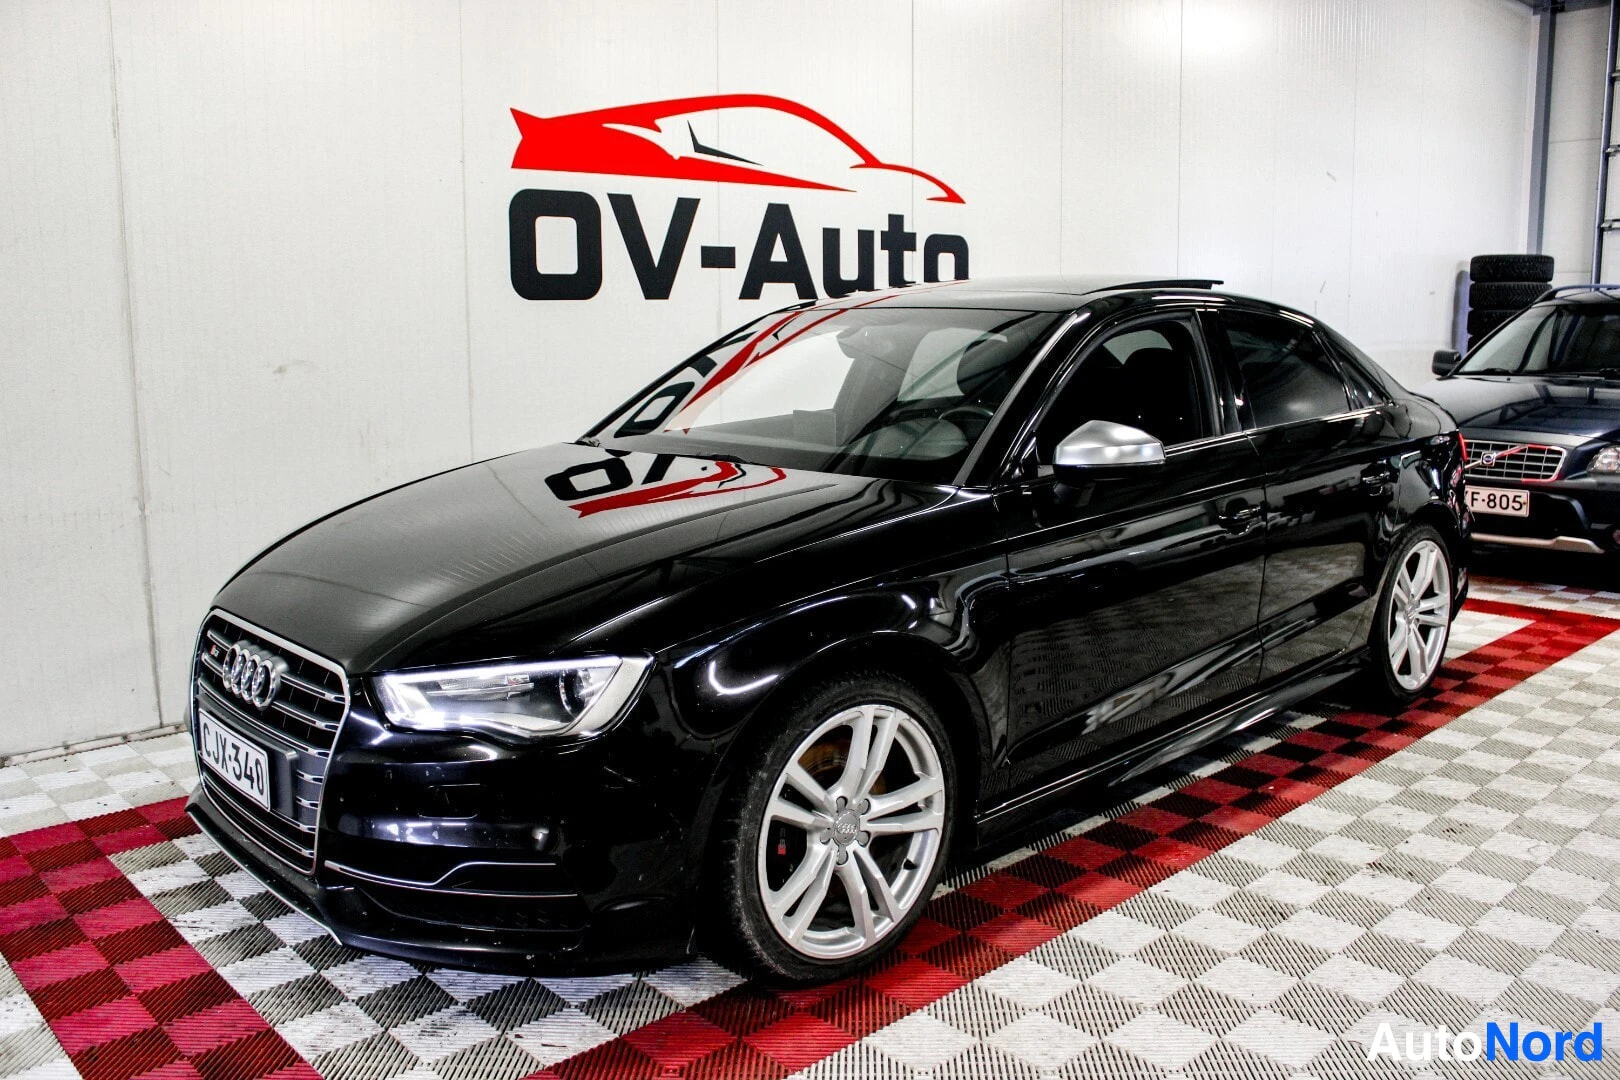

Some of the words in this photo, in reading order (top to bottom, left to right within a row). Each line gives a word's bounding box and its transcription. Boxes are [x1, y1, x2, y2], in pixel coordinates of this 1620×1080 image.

[509, 188, 969, 300] OV-Auto
[1465, 490, 1523, 511] F-805
[203, 722, 264, 796] CJX-340
